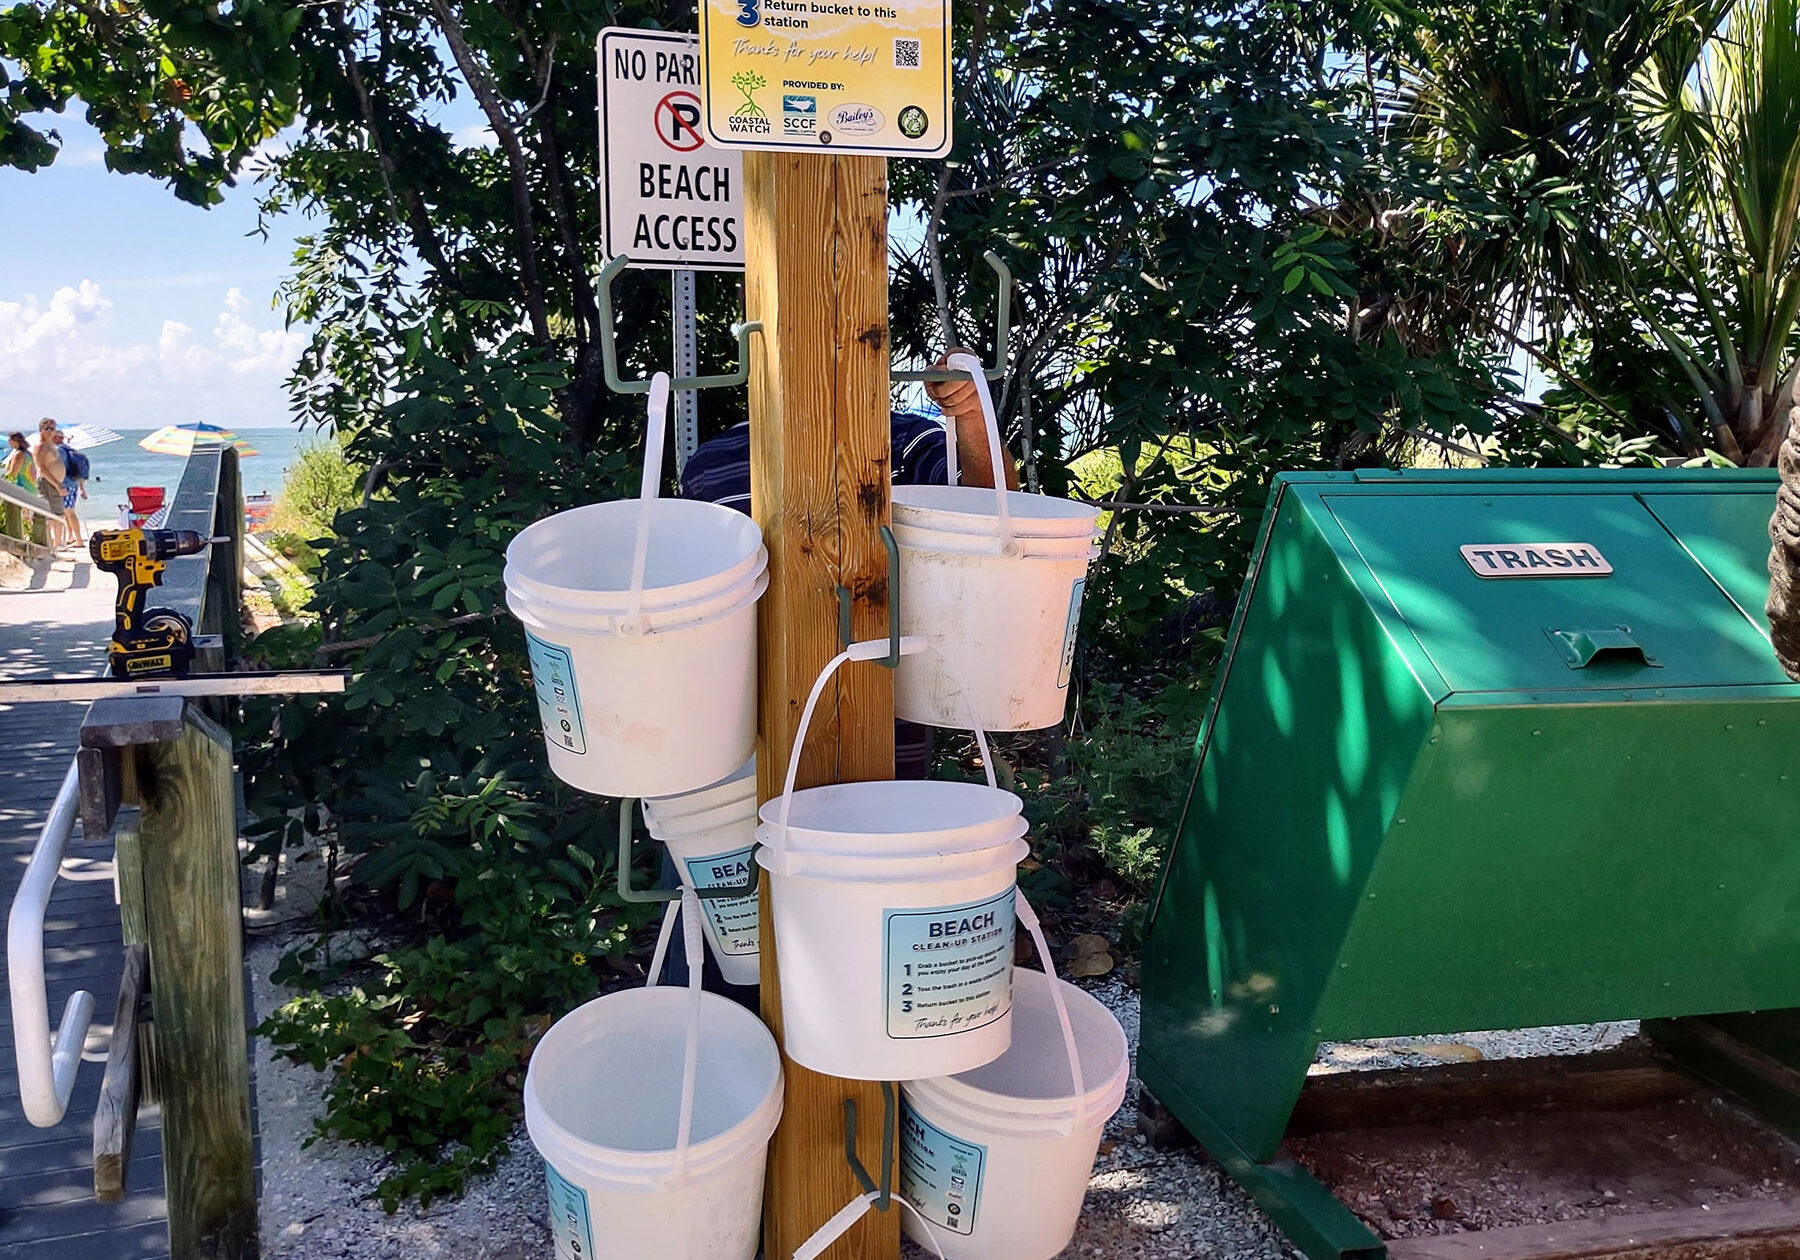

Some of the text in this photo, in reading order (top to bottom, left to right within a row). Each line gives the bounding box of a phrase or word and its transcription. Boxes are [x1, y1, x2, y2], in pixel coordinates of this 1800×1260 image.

[736, 0, 897, 27] 3 Return bucket to this
[764, 16, 809, 29] station
[732, 37, 879, 68] Thanks for your help!
[615, 48, 646, 81] NO
[783, 80, 845, 90] PROVIDED BY:
[728, 116, 771, 126] COASTAL
[784, 118, 816, 128] SCCF
[836, 108, 876, 125] Bailey's
[729, 124, 770, 134] WATCH
[639, 162, 730, 202] BEACH
[634, 214, 737, 252] ACCESS
[1472, 549, 1600, 569] TRASH
[712, 862, 748, 879] BEA
[708, 899, 716, 909] 1
[714, 914, 722, 924] 2
[929, 911, 995, 938] BEACH
[720, 926, 727, 936] 3
[912, 938, 967, 951] CLEAN-UP
[904, 964, 912, 976] 1
[939, 960, 958, 968] bucket
[902, 983, 912, 996] 2
[902, 1000, 912, 1012] 3
[914, 1015, 947, 1032] Thanks
[902, 1109, 925, 1140] ACH
